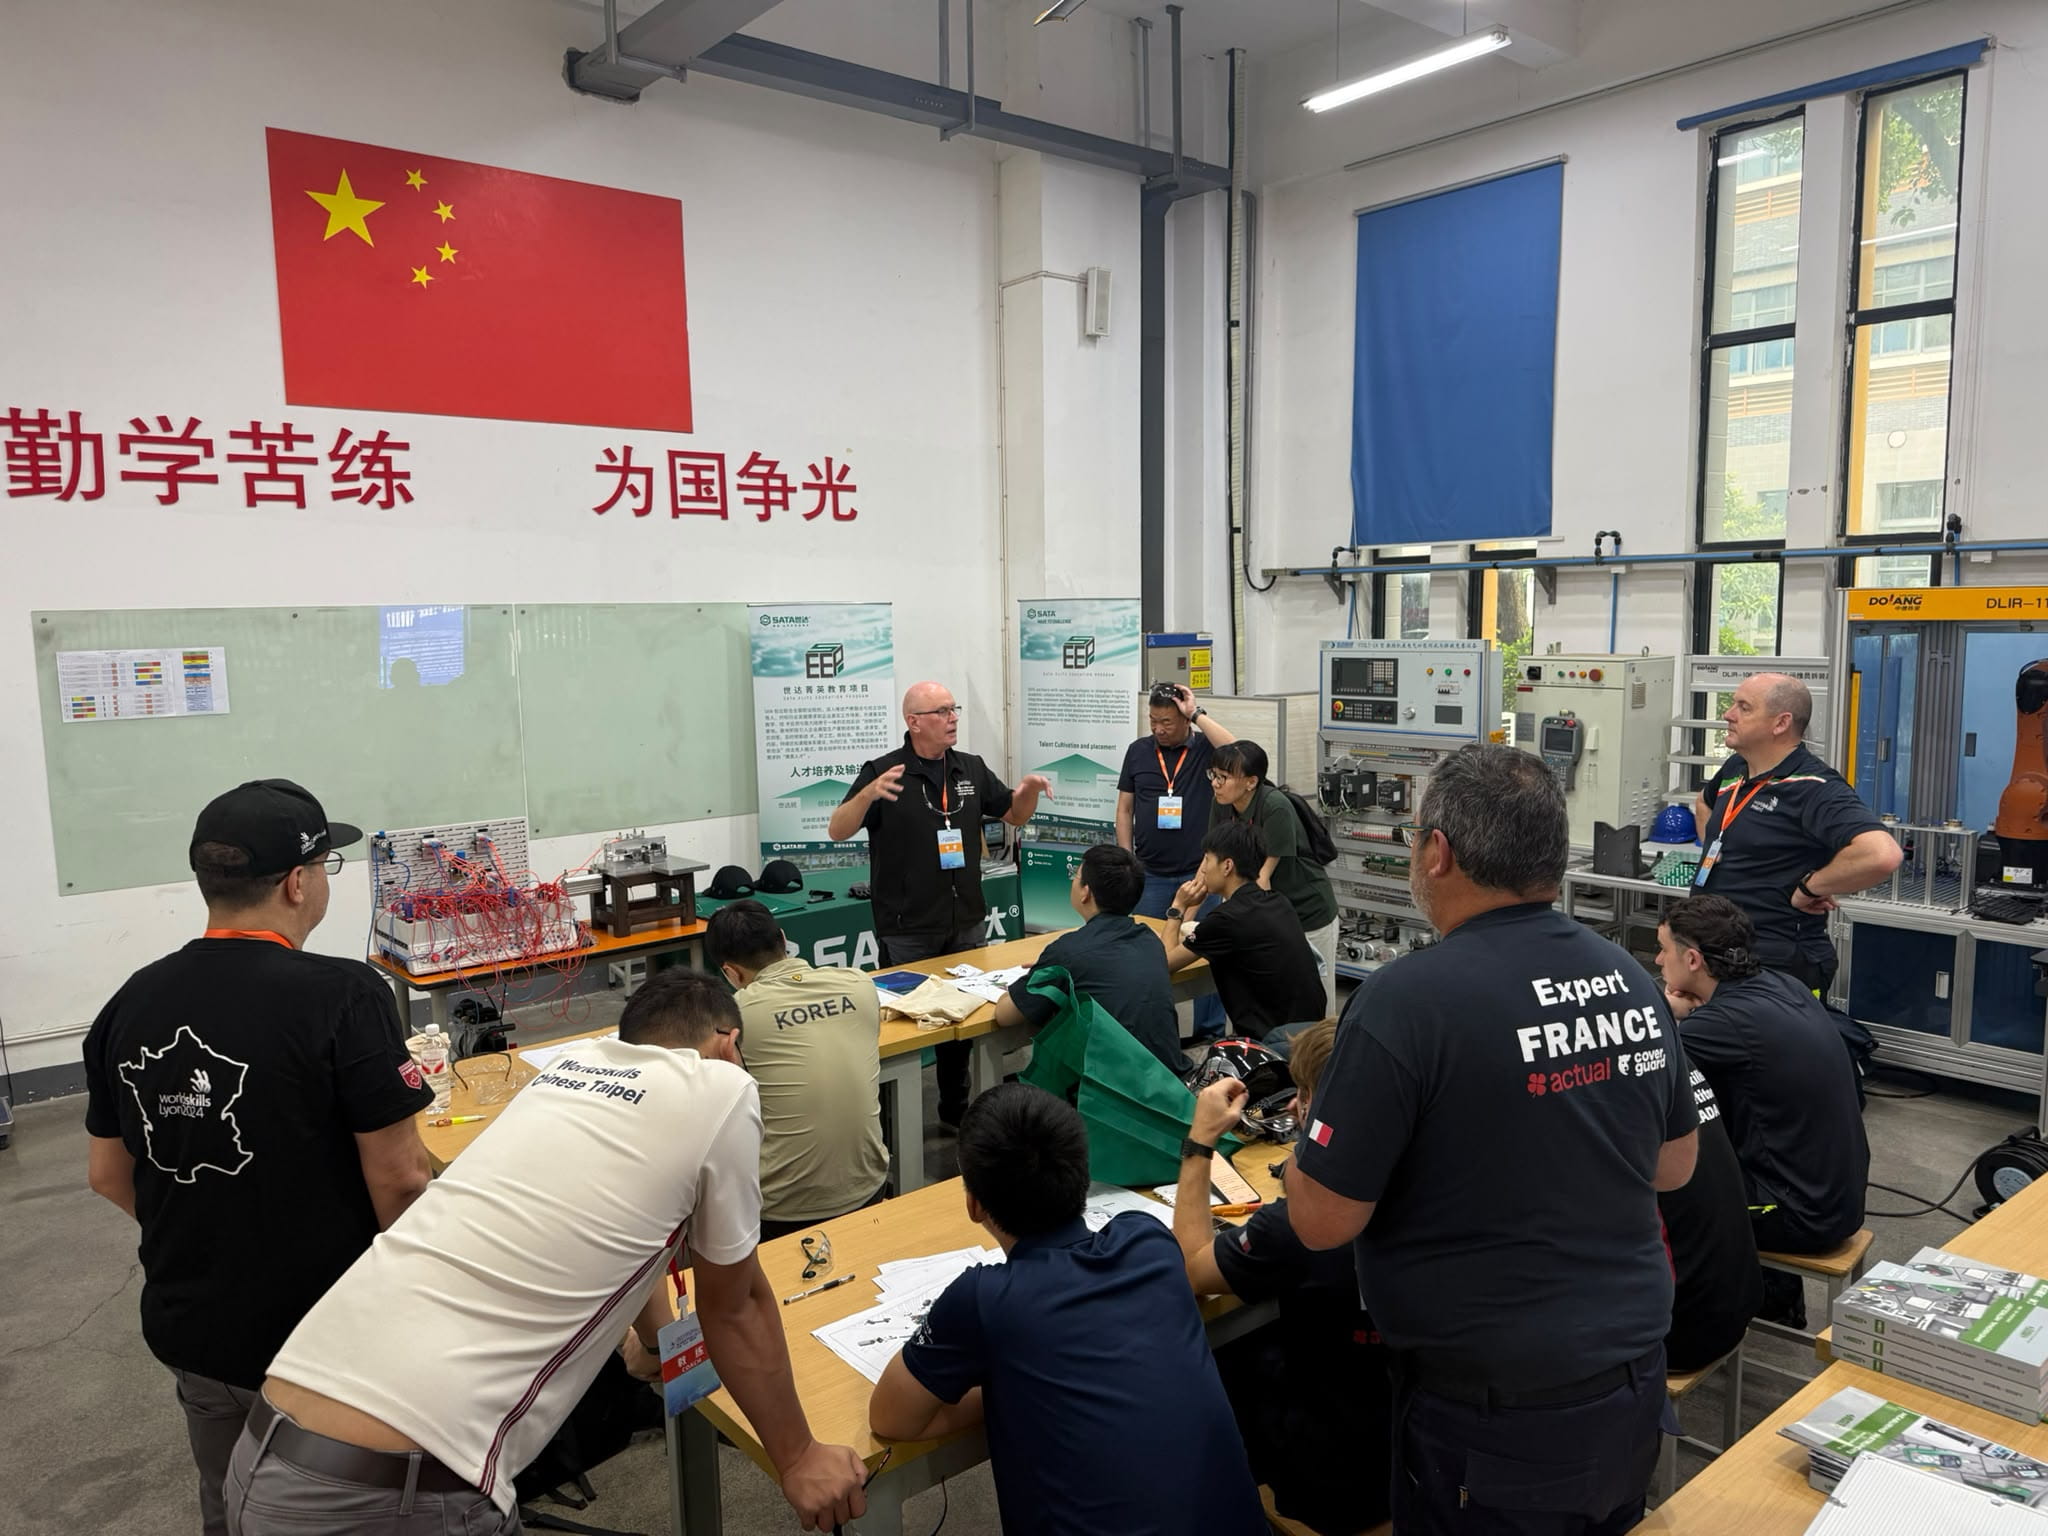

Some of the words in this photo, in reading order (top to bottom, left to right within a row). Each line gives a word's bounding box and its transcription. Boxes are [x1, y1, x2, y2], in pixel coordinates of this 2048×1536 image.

[0, 406, 415, 512] 勤学苦练
[592, 445, 859, 523] 为国争光
[1532, 969, 1630, 1007] Expert
[774, 996, 857, 1030] KOREA
[1517, 1006, 1662, 1063] FRANCE
[588, 1080, 646, 1105] Taipei
[1549, 1057, 1611, 1094] actual
